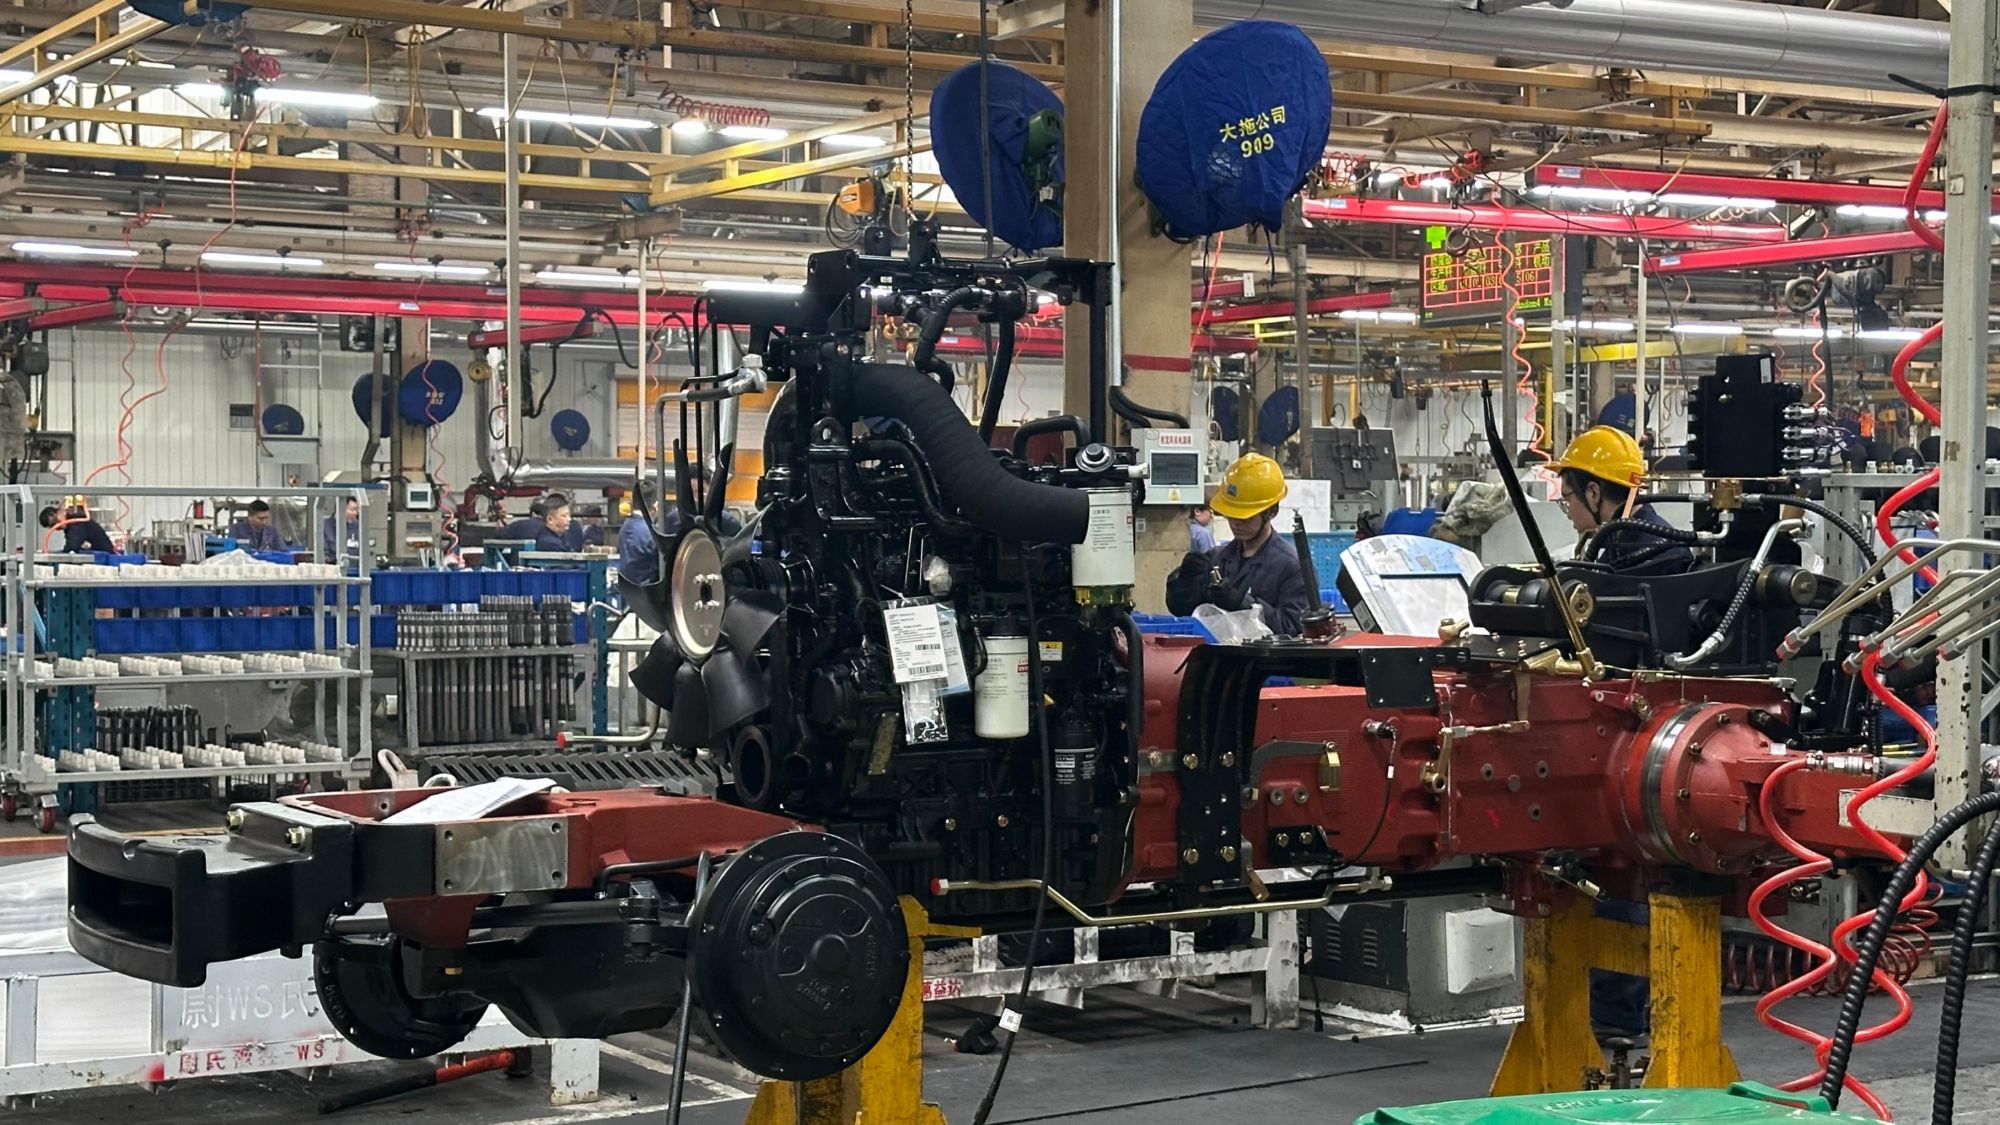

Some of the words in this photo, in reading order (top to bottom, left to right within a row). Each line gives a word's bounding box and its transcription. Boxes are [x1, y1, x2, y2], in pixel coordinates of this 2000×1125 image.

[1219, 105, 1286, 143] 大拖公司
[1240, 133, 1275, 158] 909
